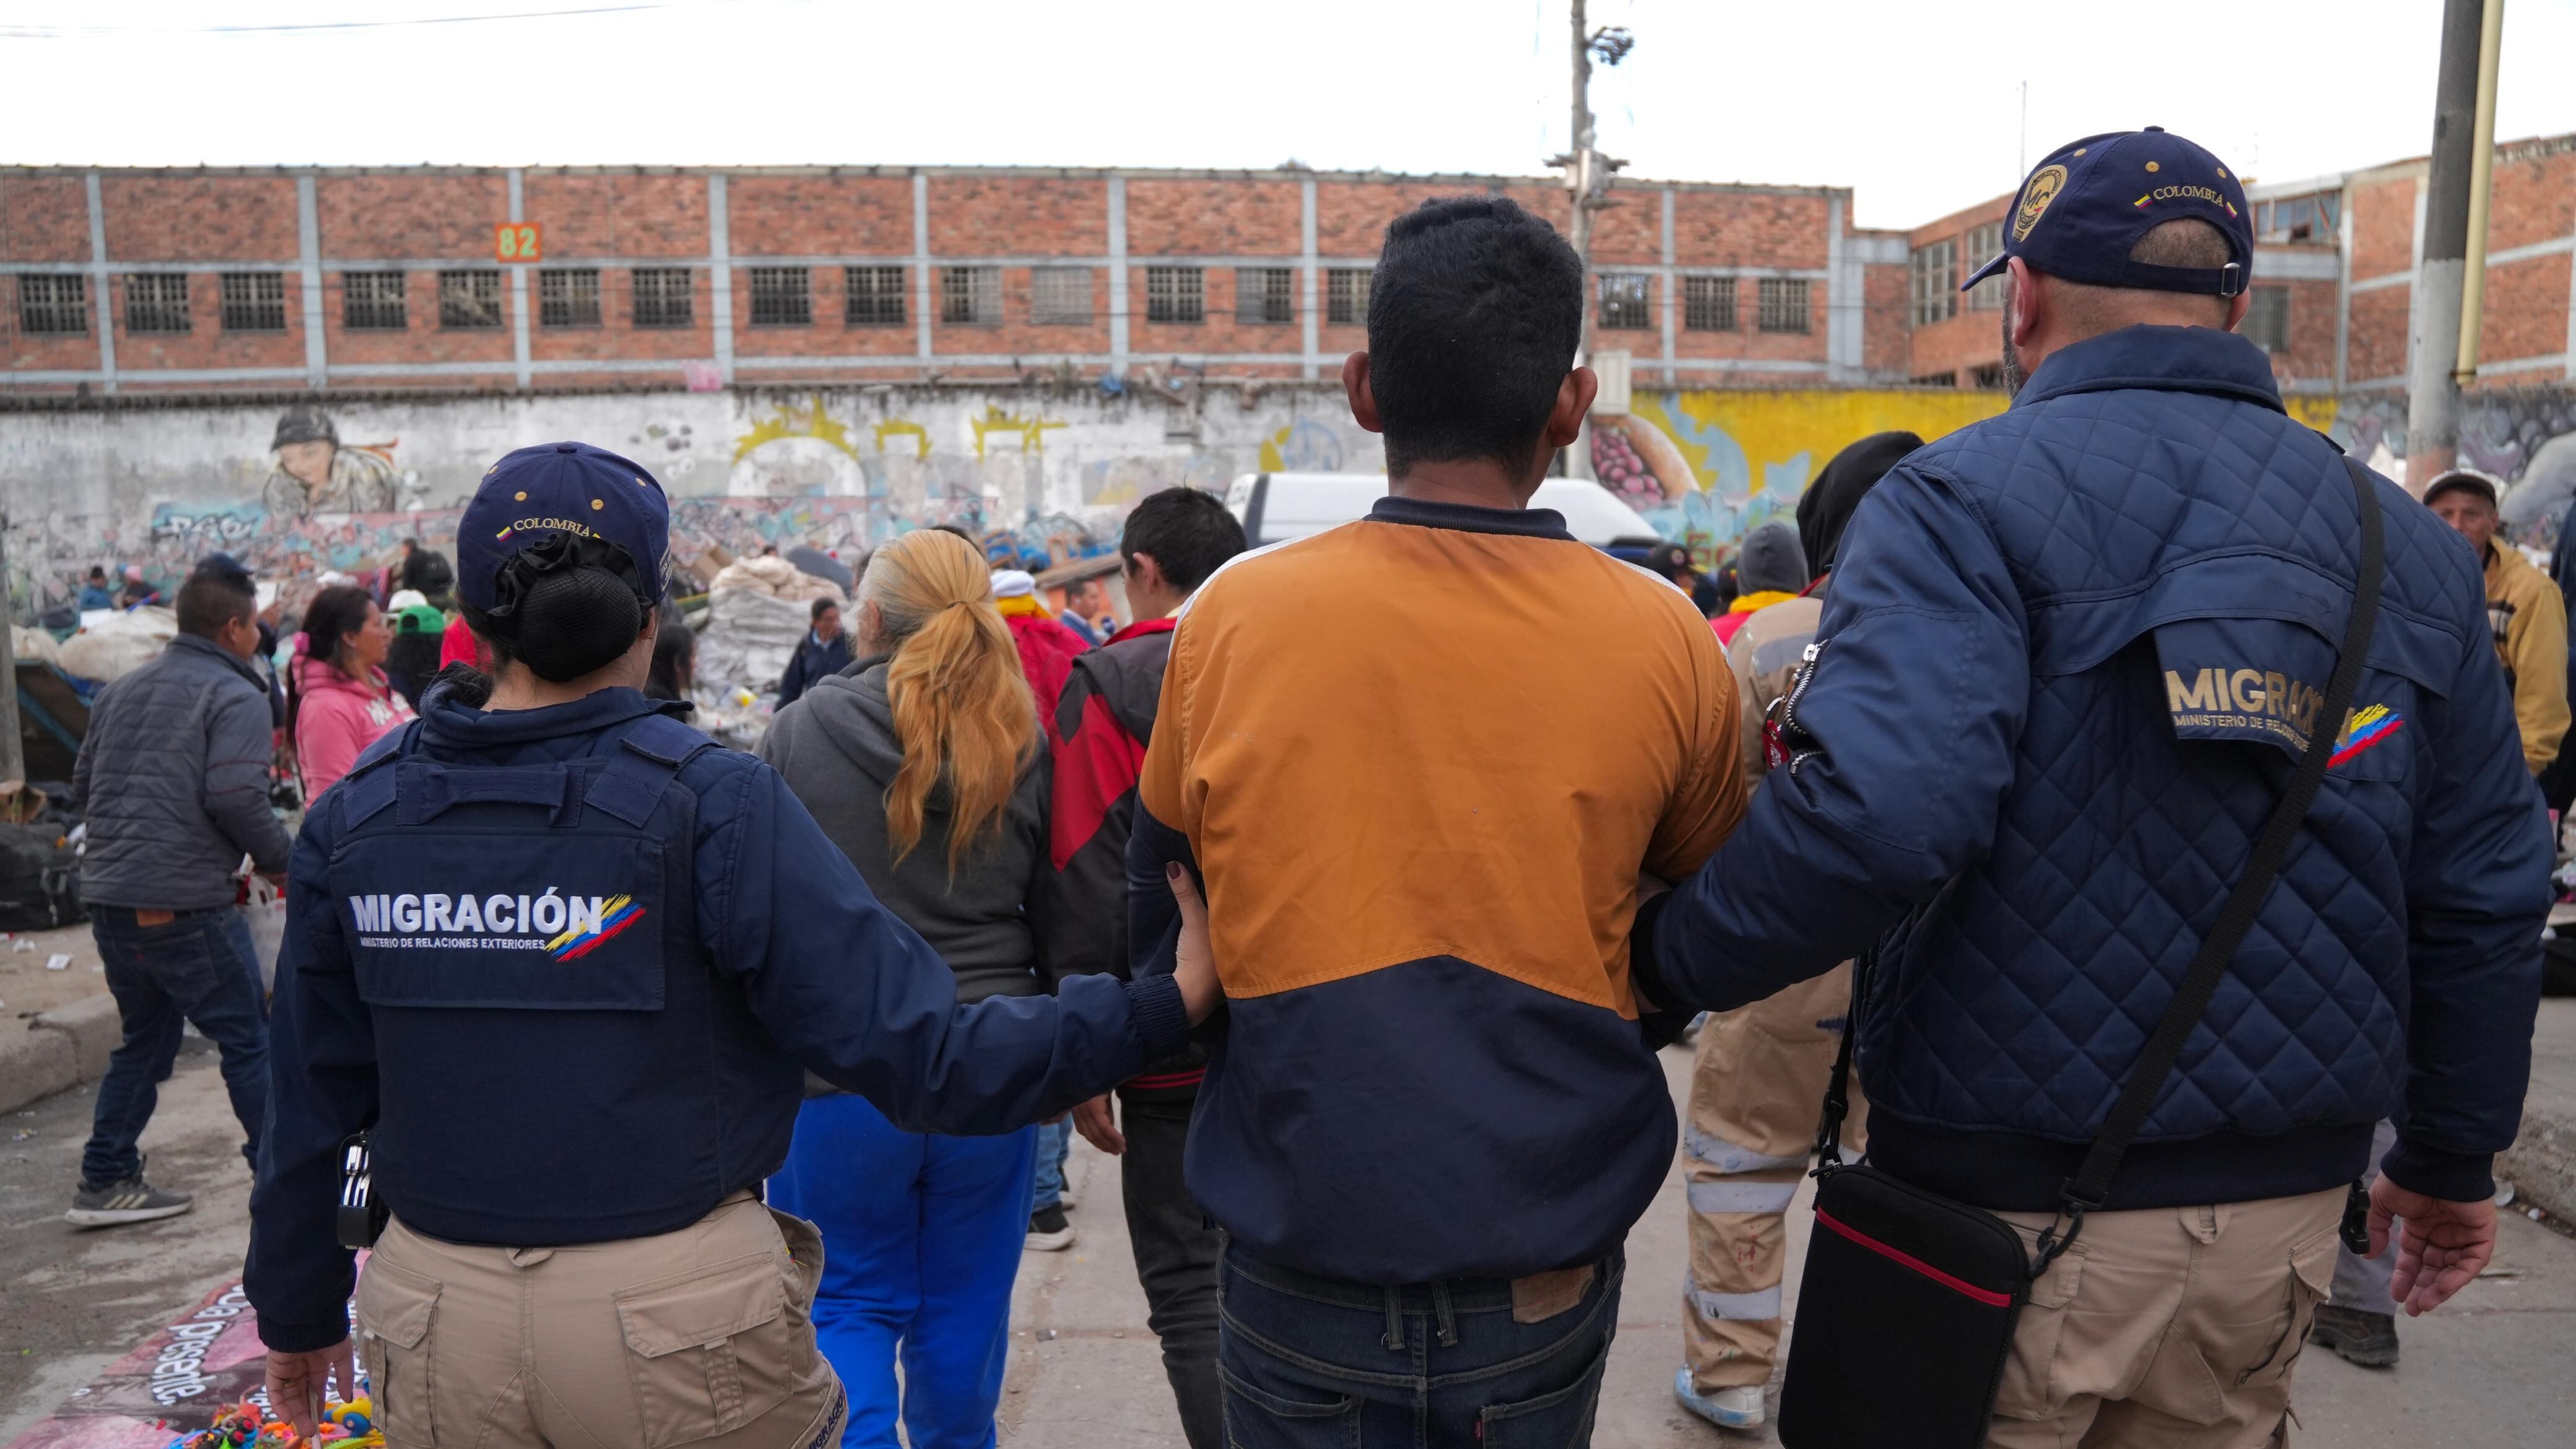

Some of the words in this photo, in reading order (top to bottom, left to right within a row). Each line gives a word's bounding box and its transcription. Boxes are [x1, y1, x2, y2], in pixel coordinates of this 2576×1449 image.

[2154, 186, 2224, 207] COLOMBIA
[499, 227, 537, 258] 82
[514, 518, 590, 537] COLOMBIA
[2174, 715, 2247, 728] MINISTERIO
[2250, 716, 2264, 729] DE
[349, 886, 603, 934] MIGRACIÓN
[360, 937, 398, 948] MINISTERIO
[401, 938, 413, 948] DE
[416, 938, 478, 949] RELACIONES
[481, 938, 546, 950] EXTERIORES
